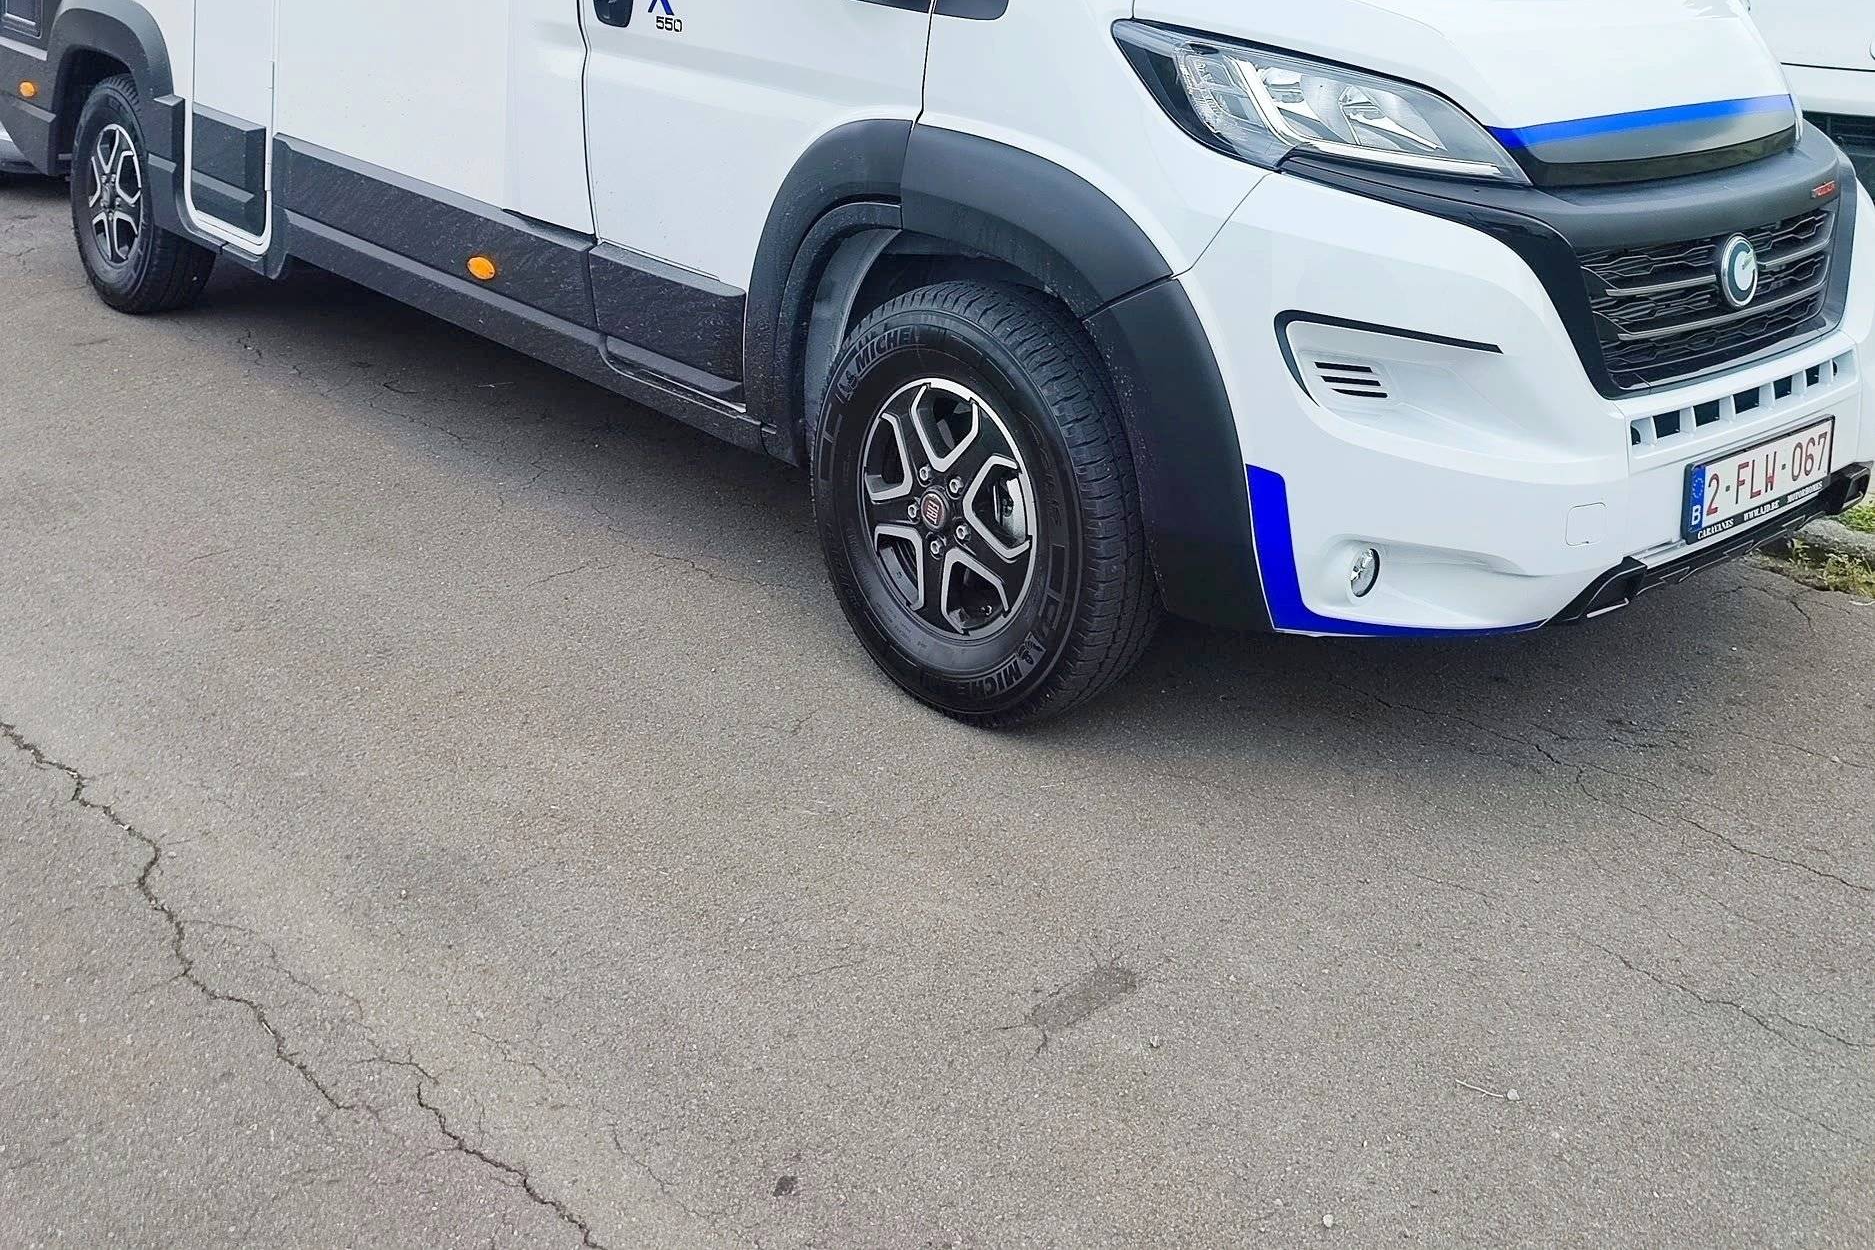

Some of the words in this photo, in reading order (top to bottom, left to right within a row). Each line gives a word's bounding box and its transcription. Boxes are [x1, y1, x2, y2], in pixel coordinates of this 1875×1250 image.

[656, 15, 682, 32] 550
[926, 500, 939, 524] FIAT
[1691, 505, 1701, 526] B
